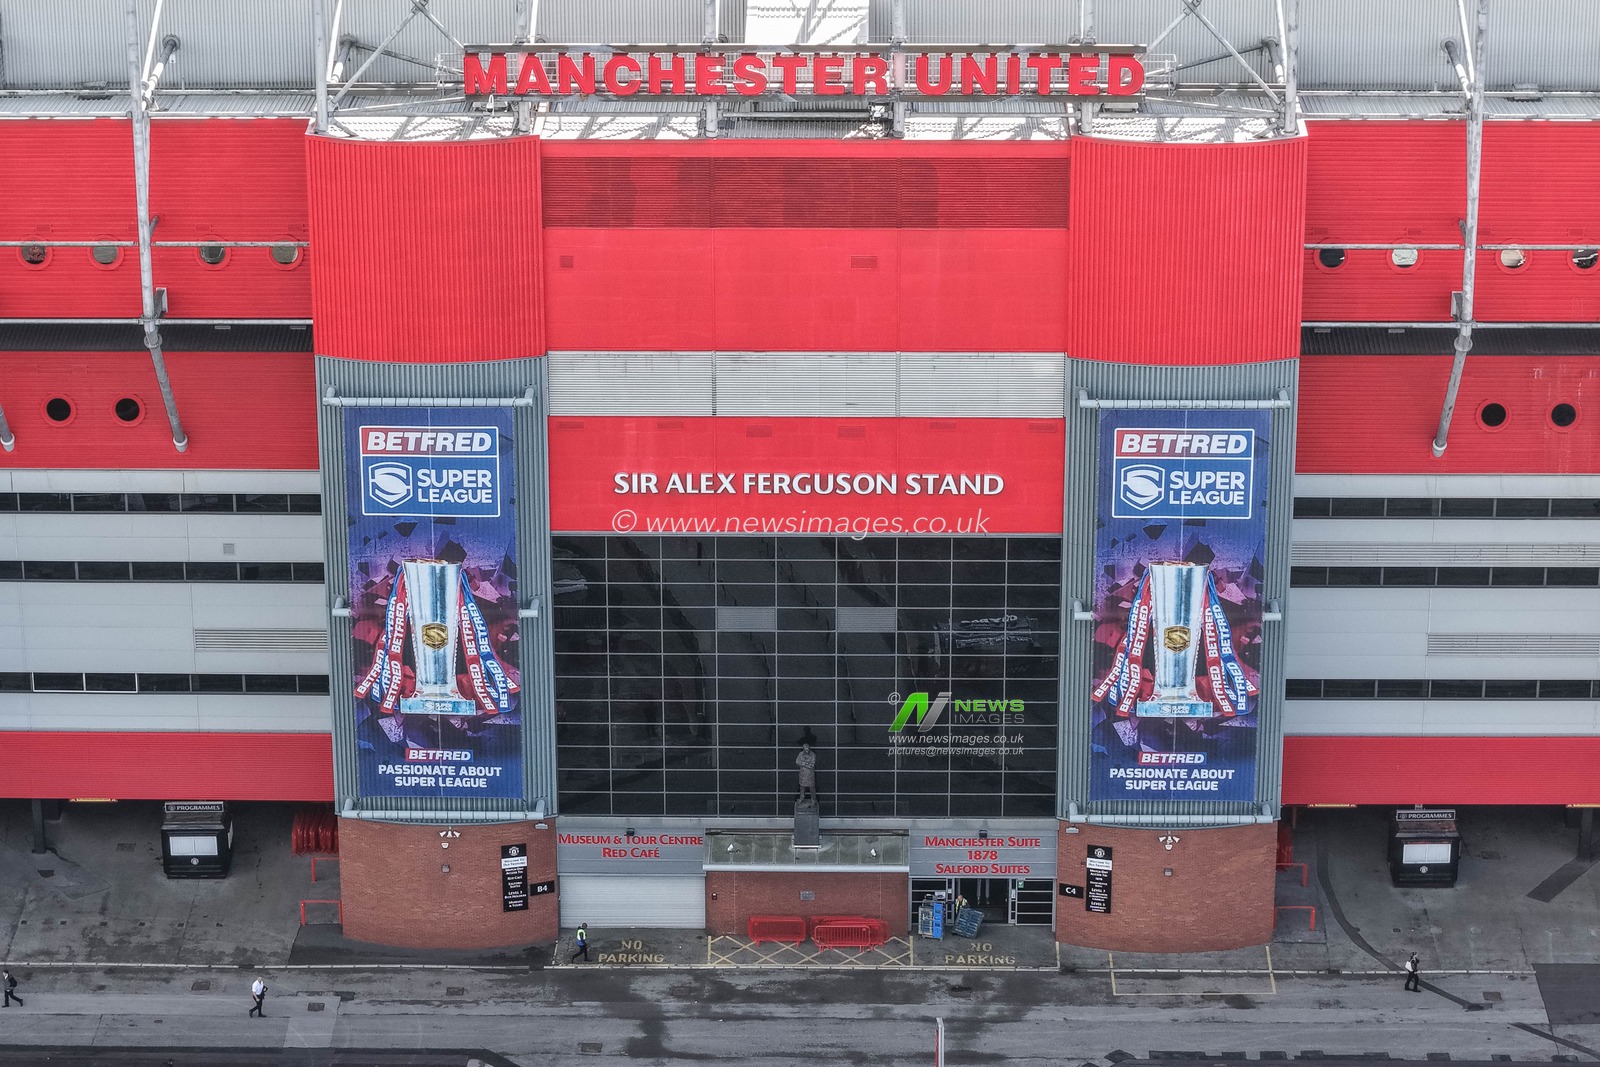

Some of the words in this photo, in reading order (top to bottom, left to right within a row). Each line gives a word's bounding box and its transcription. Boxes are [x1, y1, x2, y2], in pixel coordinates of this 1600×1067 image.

[463, 55, 888, 95] MANCHESTER
[915, 55, 1145, 95] UNITED
[367, 431, 492, 452] BETFRED
[1121, 433, 1248, 454] BETFRED
[417, 469, 492, 488] SUPER
[613, 472, 659, 495] SIR
[665, 472, 737, 495] ALEX
[743, 472, 898, 495] FERGUSON
[905, 472, 1004, 495] STAND
[1169, 471, 1245, 490] SUPER
[417, 488, 492, 504] LEAGUE
[1169, 490, 1245, 506] LEAGUE
[391, 602, 405, 653] BETFRED
[461, 605, 477, 656] BETFRED
[468, 602, 492, 653] BETFRED
[1132, 605, 1149, 657] BETFRED
[1205, 607, 1219, 658] BETFRED
[1212, 604, 1233, 655] BETFRED
[357, 649, 385, 694] BETFRED
[1094, 652, 1125, 698] BETFRED
[383, 660, 401, 710] BETFRED
[470, 663, 495, 710] BETFRED
[486, 659, 509, 708] BETFRED
[1119, 663, 1140, 713] BETFRED
[1210, 665, 1233, 713] BETFRED
[1227, 661, 1246, 711] BETFRED
[408, 750, 471, 761] BETFRED
[1141, 753, 1205, 764] BETFRED
[378, 764, 456, 776] PASSIONATE
[459, 766, 502, 777] ABOUT
[1109, 768, 1188, 779] PASSIONATE
[1190, 769, 1235, 780] ABOUT
[394, 776, 436, 787] SUPER
[439, 777, 487, 788] LEAGUE
[1125, 780, 1167, 790] SUPER
[1170, 780, 1219, 791] LEAGUE
[613, 835, 622, 845] &
[967, 850, 998, 860] 1878
[537, 884, 548, 893] B4
[1065, 886, 1076, 895] C4
[621, 940, 643, 950] NO
[598, 953, 665, 963] PARKING
[945, 954, 1016, 965] PARKING
